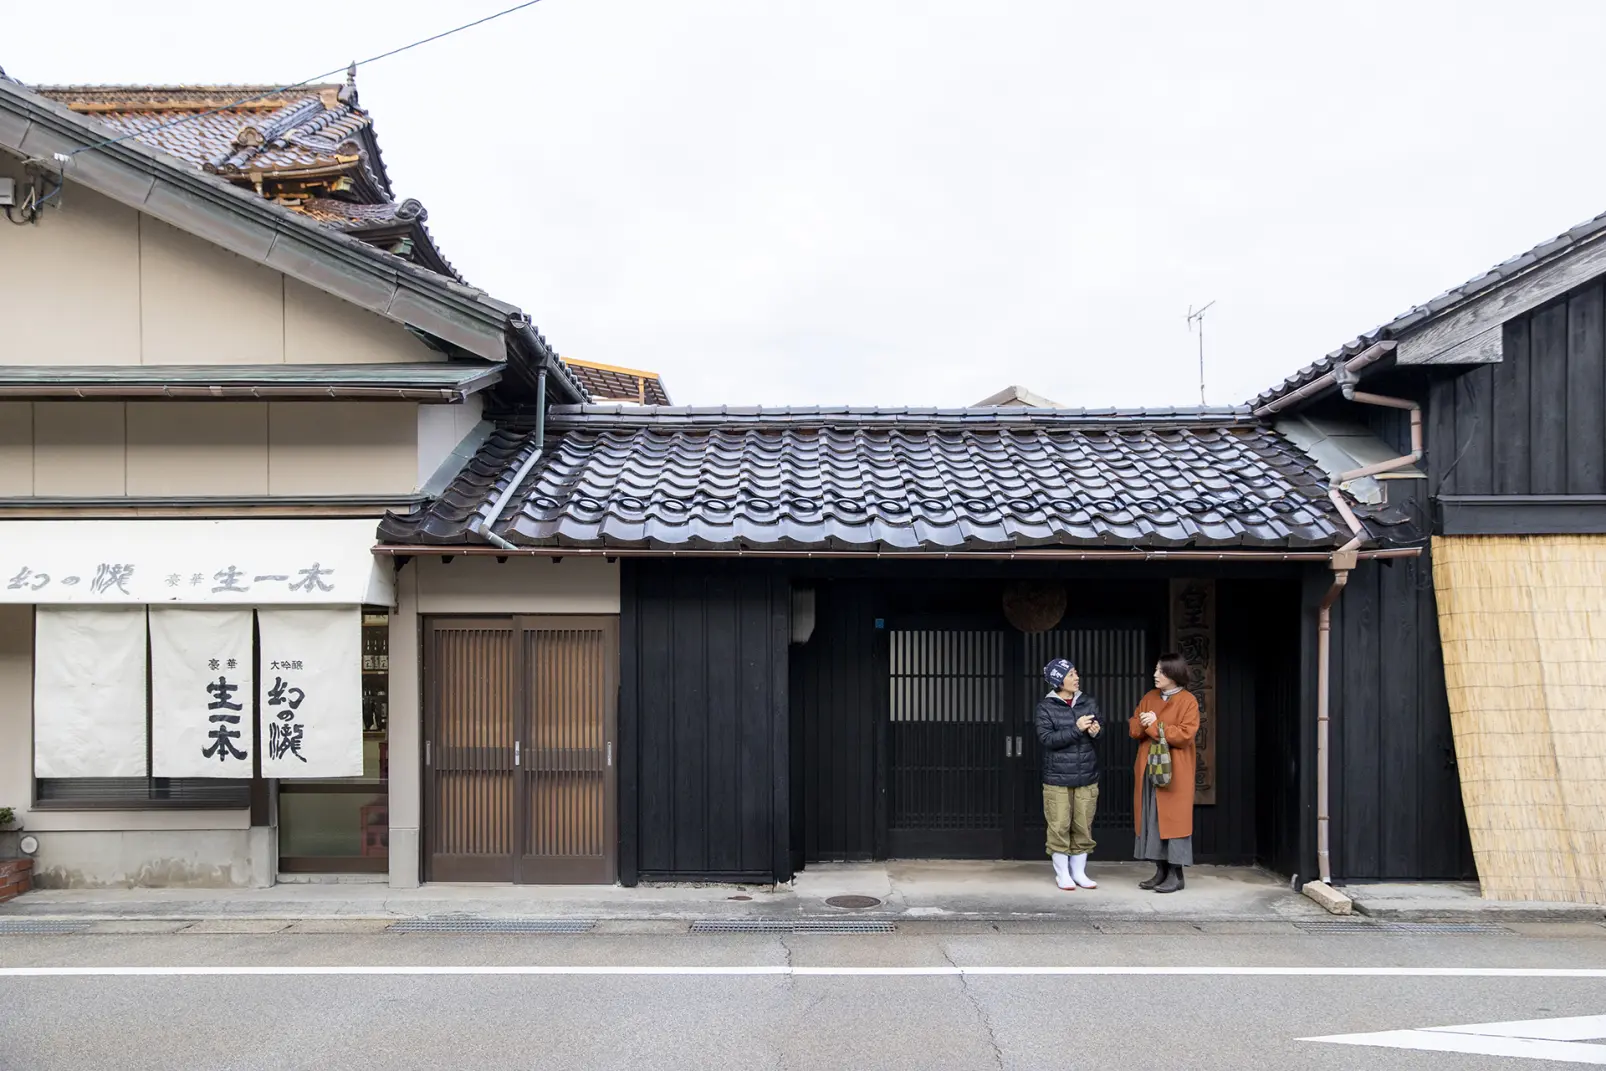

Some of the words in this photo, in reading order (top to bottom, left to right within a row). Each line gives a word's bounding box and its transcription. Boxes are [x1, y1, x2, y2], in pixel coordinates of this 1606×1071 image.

[7, 563, 135, 595] 幻の瀧
[211, 562, 335, 593] 生一本
[207, 658, 238, 671] 豪華
[202, 676, 248, 762] 生一本
[267, 677, 308, 763] 幻の瀧
